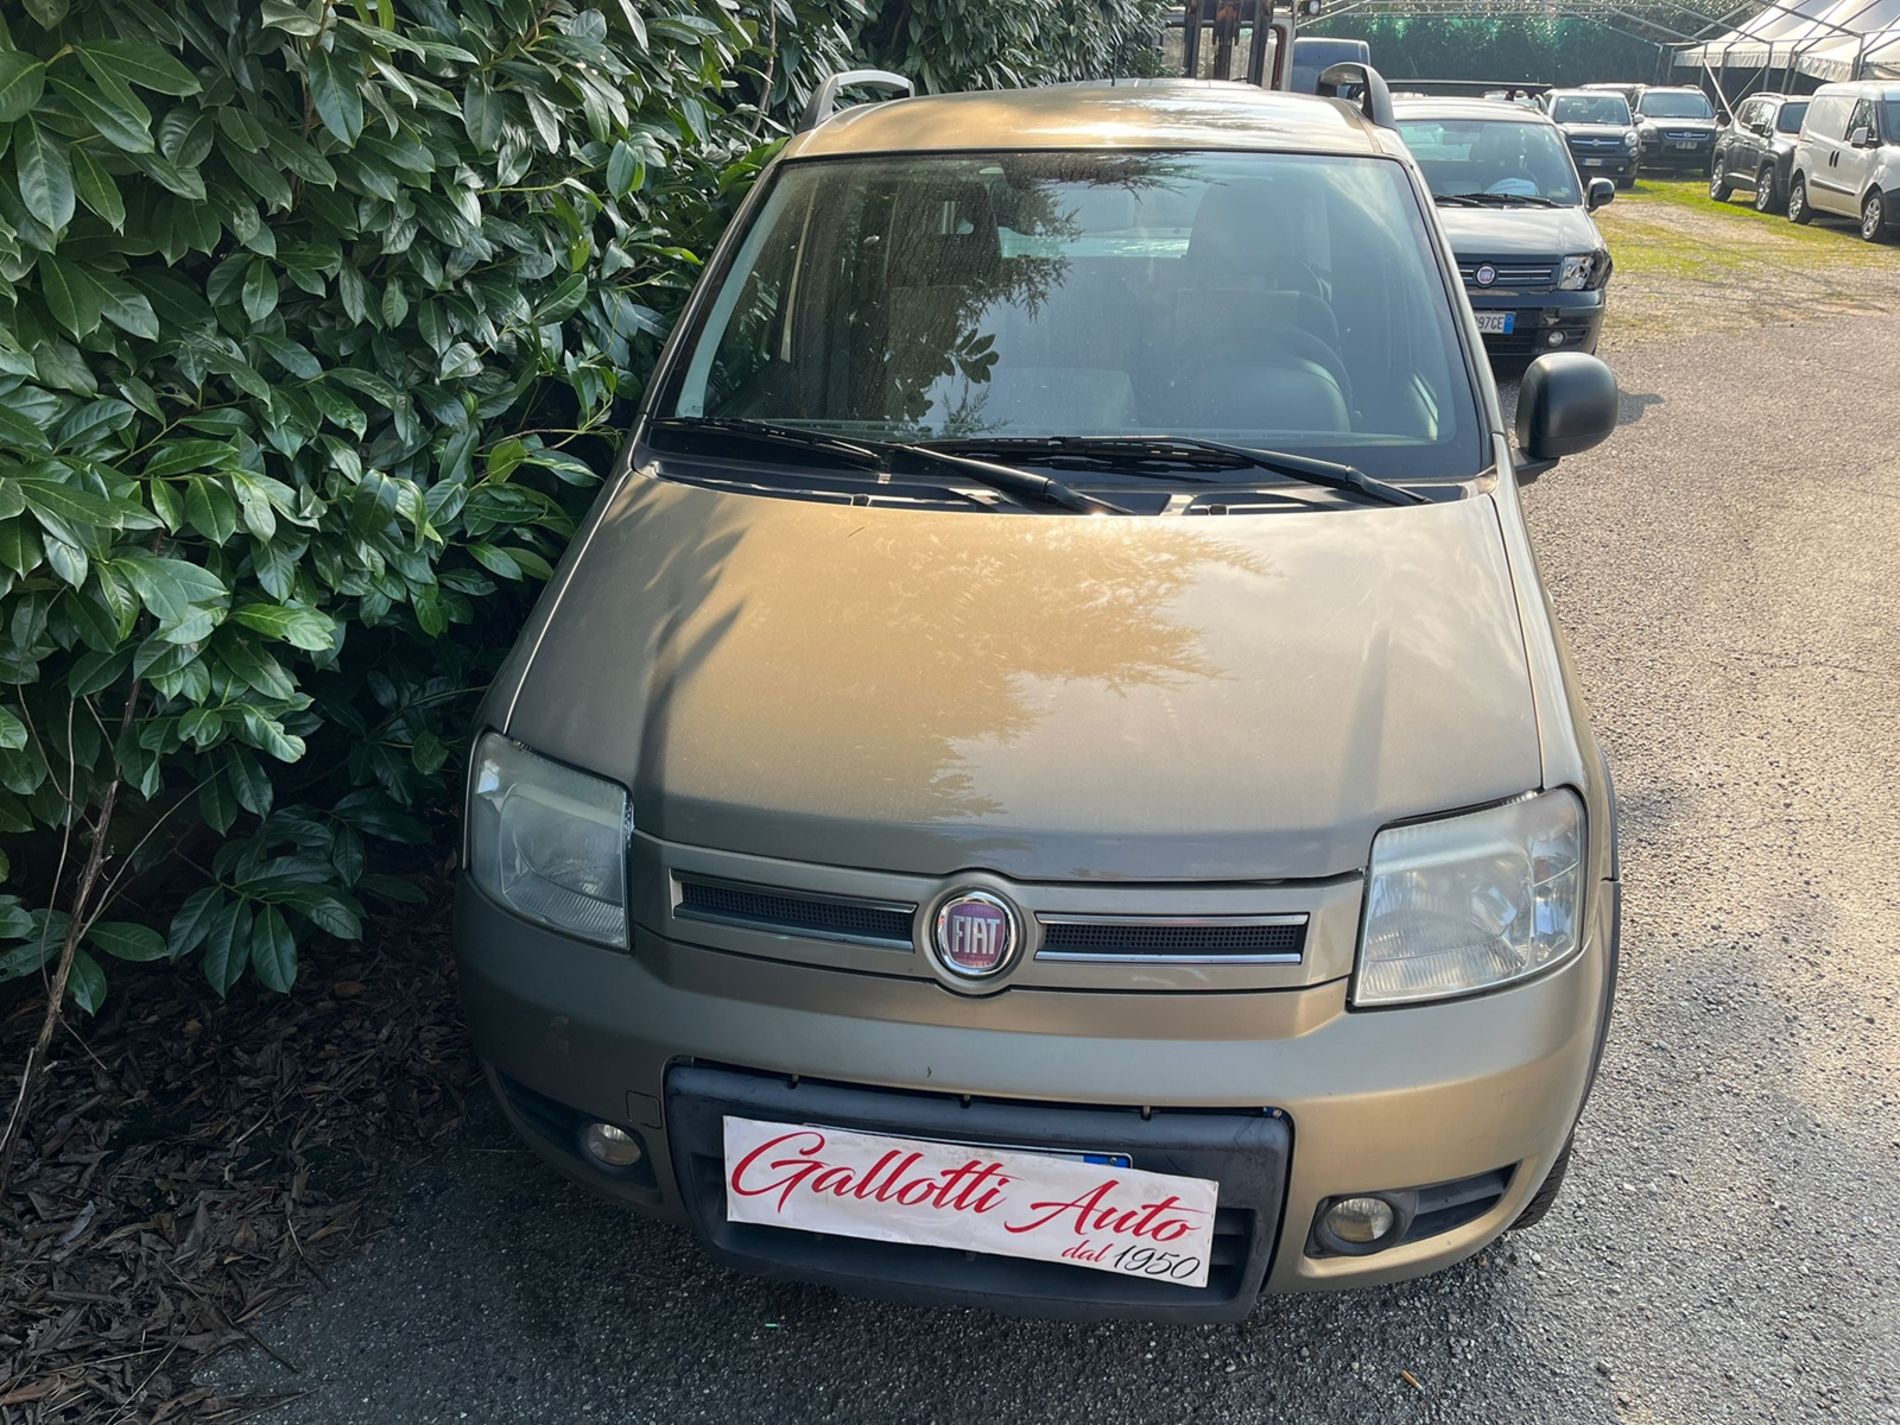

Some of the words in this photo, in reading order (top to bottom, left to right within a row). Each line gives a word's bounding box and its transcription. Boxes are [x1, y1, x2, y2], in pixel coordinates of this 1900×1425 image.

[953, 916, 1000, 954] FIAT
[731, 1131, 1018, 1213] Gallotti
[1003, 1179, 1208, 1242] Auto
[1061, 1240, 1114, 1263] dal
[1113, 1245, 1200, 1280] 1950
